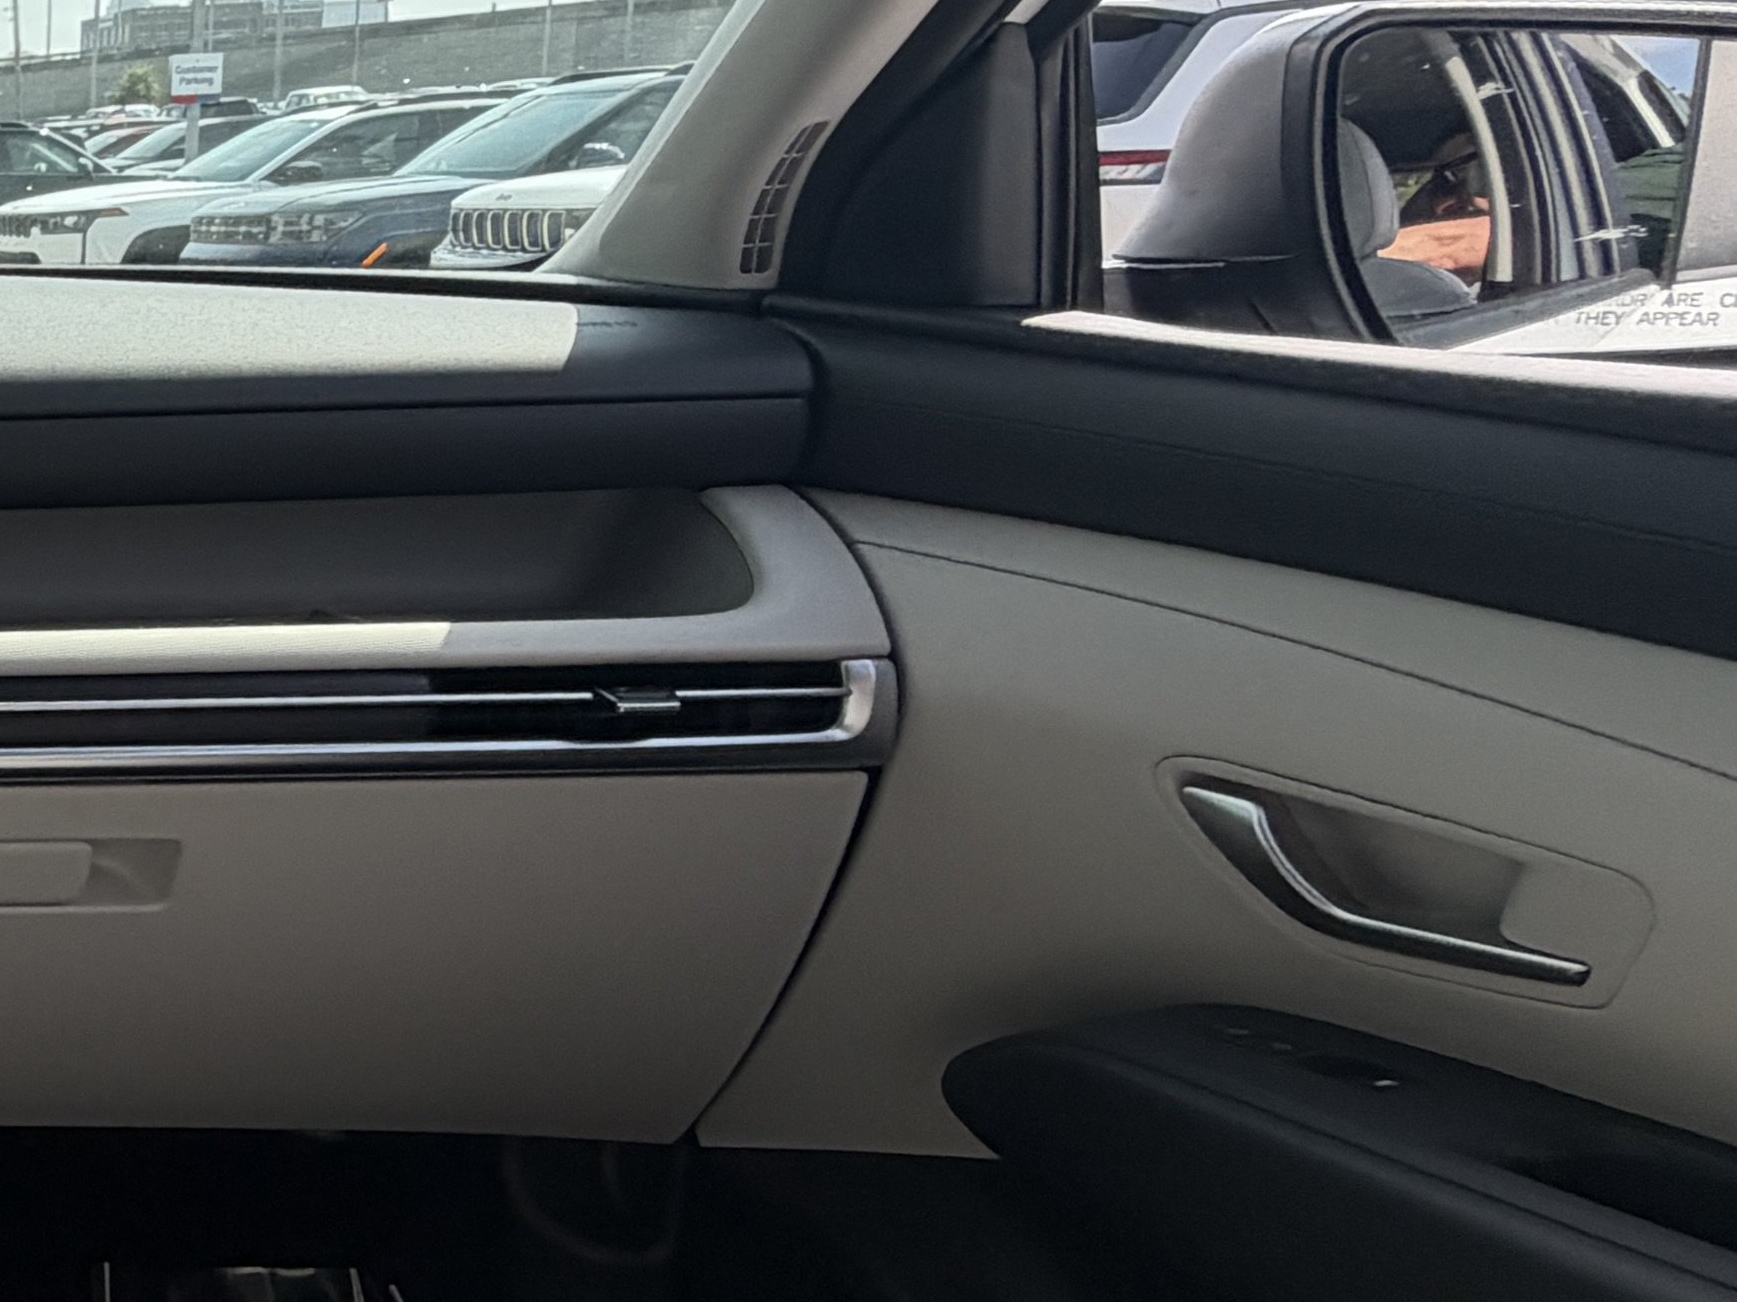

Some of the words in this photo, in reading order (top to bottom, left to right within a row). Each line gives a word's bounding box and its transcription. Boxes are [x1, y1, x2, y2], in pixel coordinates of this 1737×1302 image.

[1661, 291, 1704, 308] ARE
[1575, 310, 1626, 327] THEY
[1635, 311, 1721, 327] APPEAR
